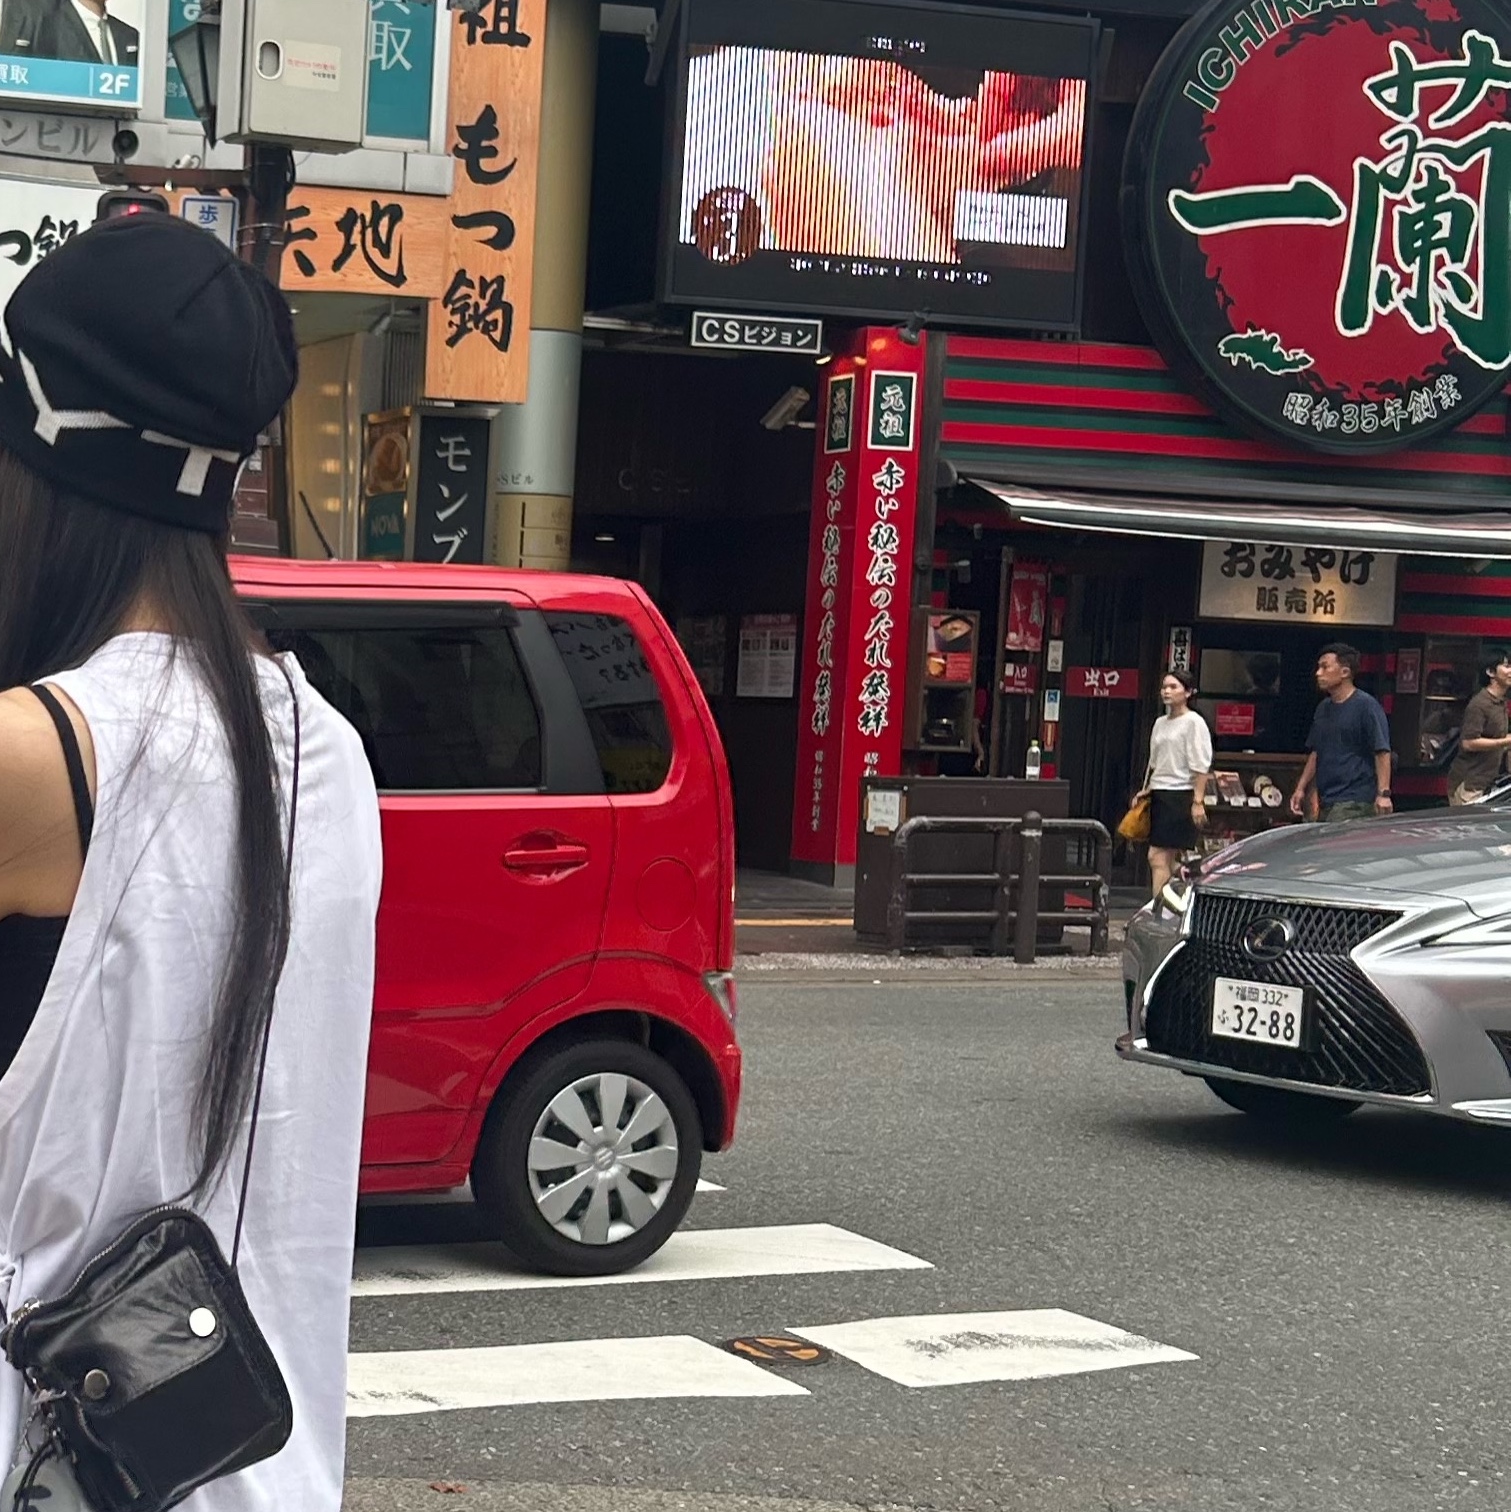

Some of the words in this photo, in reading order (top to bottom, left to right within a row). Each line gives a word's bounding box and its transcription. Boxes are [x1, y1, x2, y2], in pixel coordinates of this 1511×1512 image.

[368, 0, 413, 71] 取
[1182, 0, 1378, 114] ICHIR
[99, 72, 131, 95] 2F
[1168, 29, 1511, 371] 一蘭
[701, 318, 813, 348] CSビジョン
[878, 383, 907, 439] 元祖
[1281, 374, 1464, 435] 昭和35年創業
[1256, 586, 1337, 616] 販売所
[1083, 667, 1120, 688] 出口
[1235, 985, 1260, 1002] 福岡
[1261, 989, 1284, 1007] 332
[1231, 1004, 1296, 1042] 32-88
